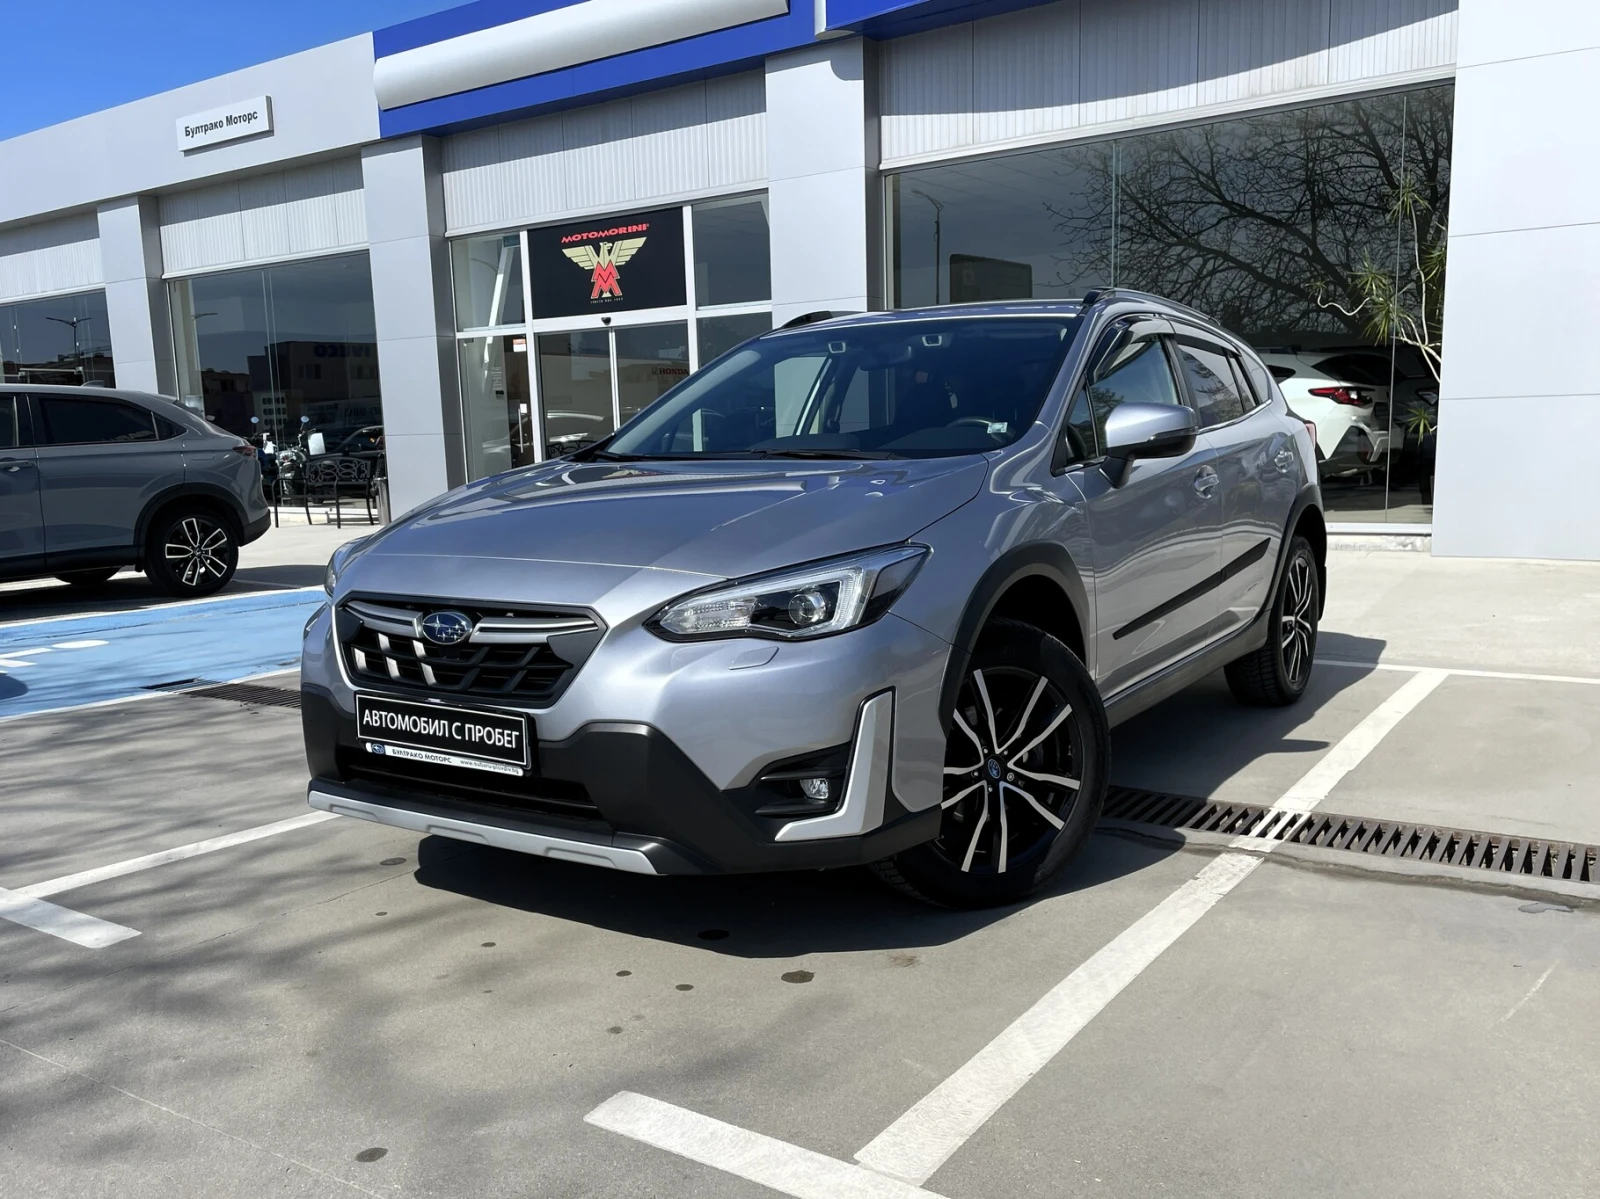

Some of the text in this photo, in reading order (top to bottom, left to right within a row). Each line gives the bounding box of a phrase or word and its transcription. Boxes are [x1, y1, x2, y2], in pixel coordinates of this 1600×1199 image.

[184, 111, 258, 138] Бултрако Моторс
[659, 368, 690, 376] HONDA
[363, 709, 520, 749] АВТОМОБИЛ С ПРОБЕГ
[392, 748, 452, 764] БУЛТРАКО МОТОРС
